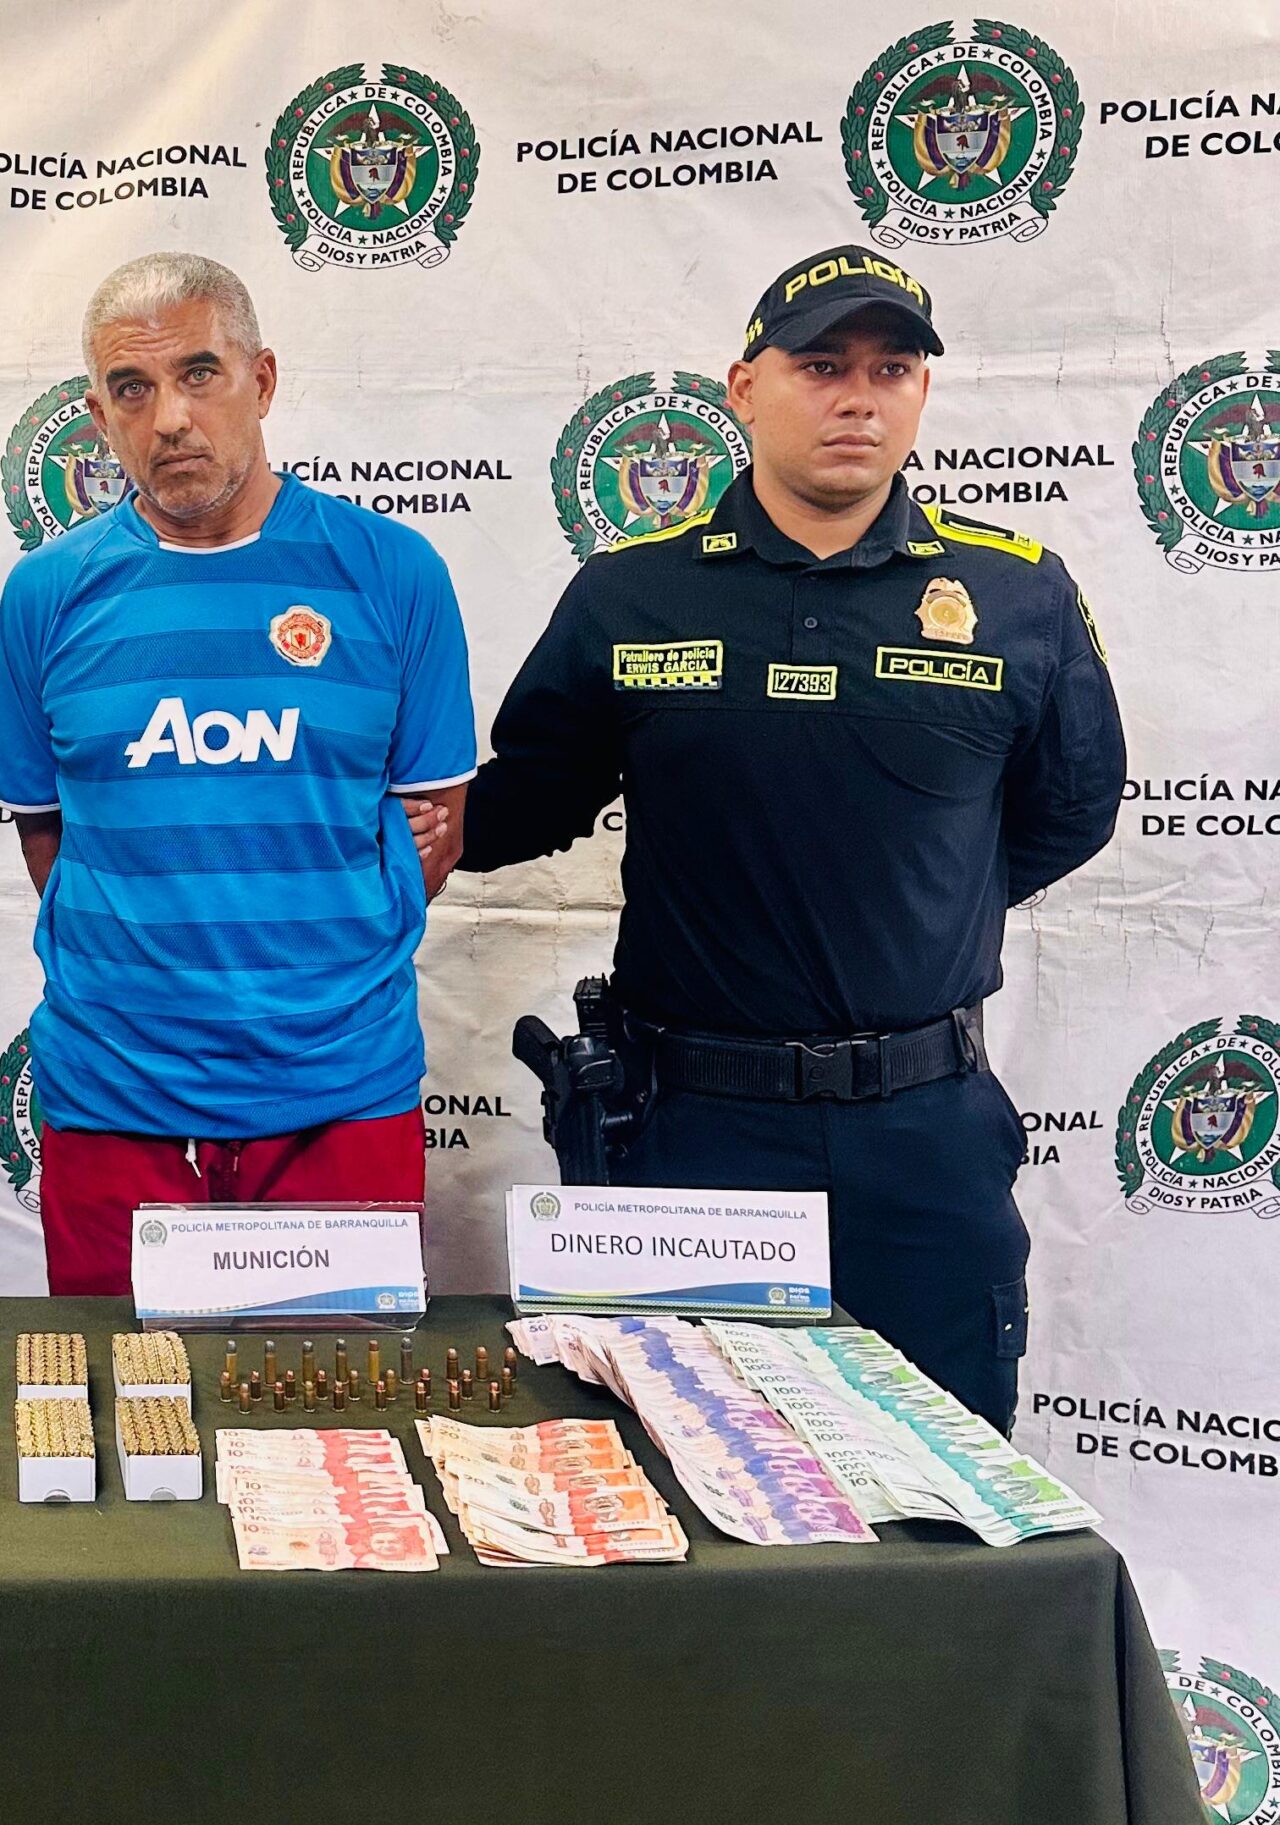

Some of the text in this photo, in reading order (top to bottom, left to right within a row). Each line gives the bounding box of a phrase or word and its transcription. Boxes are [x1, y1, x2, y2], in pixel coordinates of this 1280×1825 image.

[871, 46, 1053, 151] REPÚBLICA DE COLOMBIA
[1100, 89, 1240, 125] POLICÍA
[292, 86, 453, 180] REPÚBLICA DE COLOMBIA
[516, 121, 823, 163] POLICÍA NACIONAL
[1145, 134, 1190, 159] DE
[96, 144, 247, 179] NACIONAL
[557, 159, 779, 194] DE COLOMBIA
[881, 161, 1045, 219] POLICÍA NACIONAL
[10, 176, 209, 211] DE COLOMBIA
[300, 196, 445, 246] POLICÍA NACIONAL
[959, 212, 1022, 240] PATRIA
[371, 240, 427, 265] PATRIA
[785, 256, 924, 306] POLICÍA
[1164, 375, 1273, 477] REPÚBLICA DE
[28, 403, 81, 487] REPÚBLICA
[580, 396, 678, 490] REPÚBLICA DE
[351, 459, 513, 482] NACIONAL
[947, 444, 1115, 471] NACIONAL
[913, 481, 1069, 506] OLOMBIA
[1173, 495, 1236, 545] POLICÍA
[626, 663, 659, 674] ERWIS
[774, 671, 830, 693] 127393
[889, 660, 989, 683] POLICÍA
[1122, 773, 1235, 801] OLICÍA
[1141, 814, 1186, 836] DE
[1139, 1037, 1237, 1132] REPÚBLICA DE
[424, 1094, 512, 1117] ONAL
[1022, 1110, 1104, 1134] ONAL
[1141, 1150, 1183, 1187] POLICÍA
[574, 1201, 807, 1220] POLICÍA METROPOLITANA DE BARRANQUILLA
[1201, 1187, 1263, 1209] PATRIA
[171, 1218, 408, 1233] POLICÍA METROPOLITANA DE BARRANQUILLA
[213, 1245, 330, 1270] MUNICIÓN
[551, 1233, 796, 1262] DINERO INCAUTADO
[529, 1324, 549, 1333] 50
[773, 1386, 801, 1395] 100
[786, 1401, 814, 1410] 100
[1033, 1393, 1167, 1429] POLICÍA
[804, 1418, 834, 1428] 100
[814, 1433, 844, 1442] 100
[1076, 1432, 1279, 1477] DE COLOMB
[242, 1524, 259, 1533] 10
[1179, 1676, 1205, 1692] DE
